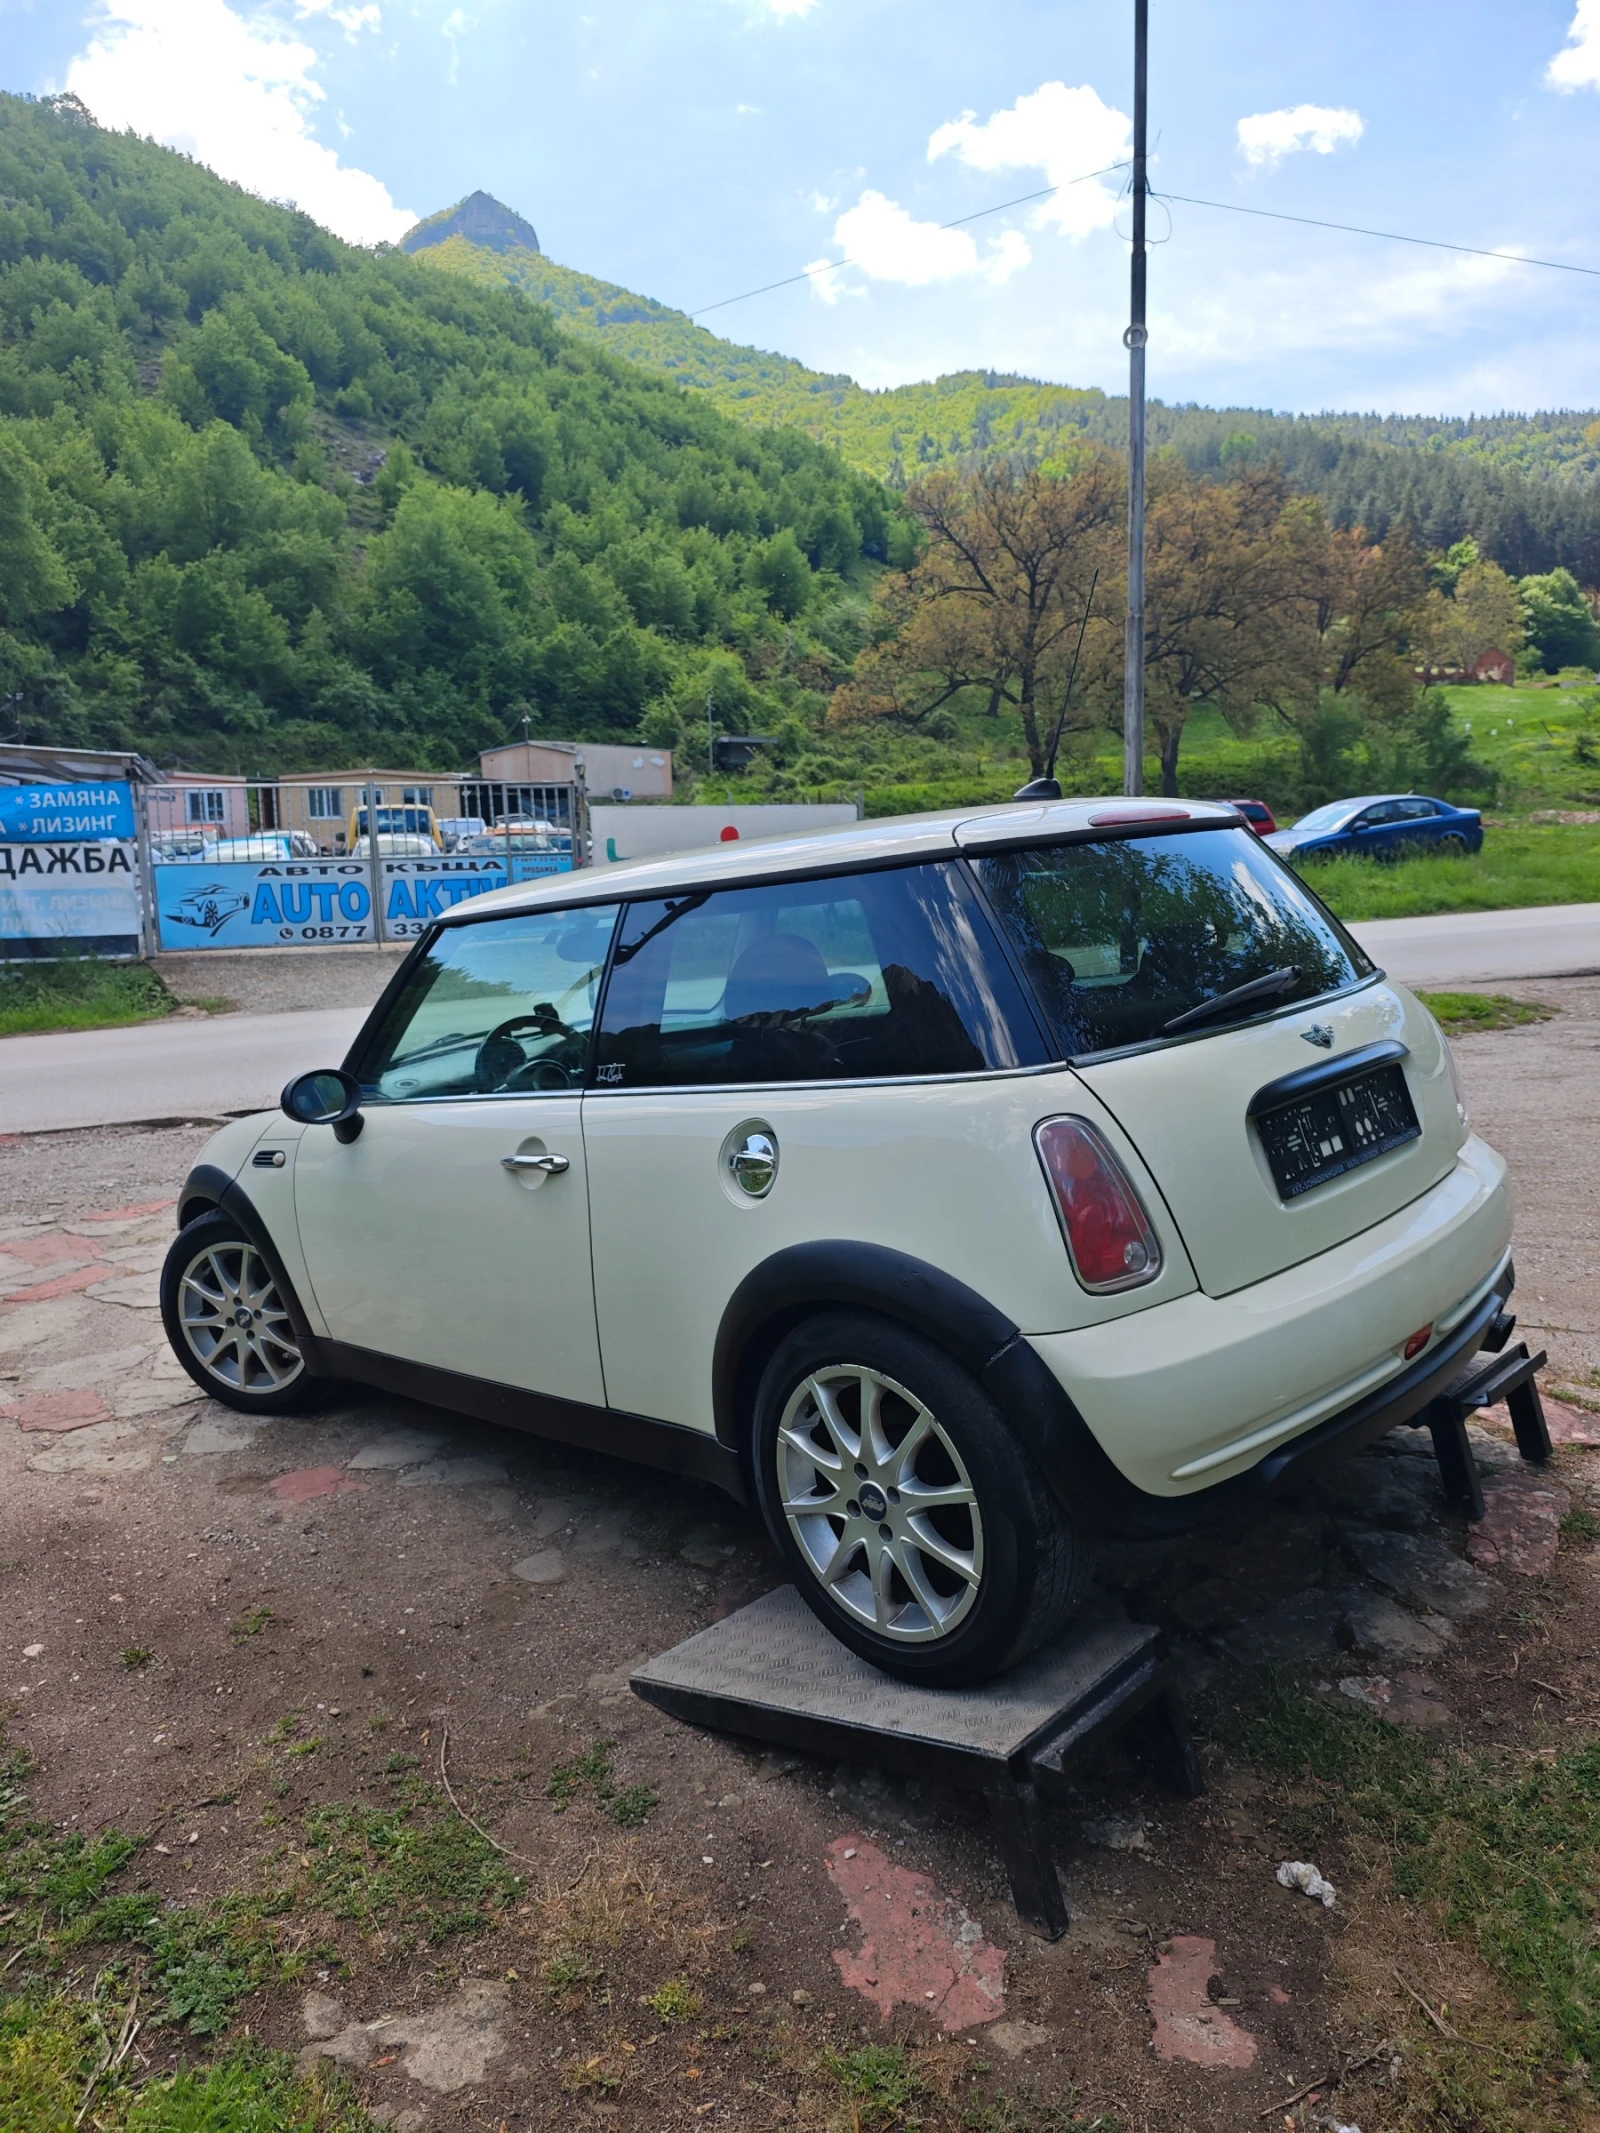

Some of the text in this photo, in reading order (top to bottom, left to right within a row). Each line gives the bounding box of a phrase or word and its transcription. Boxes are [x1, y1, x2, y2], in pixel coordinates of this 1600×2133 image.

[29, 789, 121, 809] ЗАМЯНА
[31, 814, 117, 834] ЛИЗИНГ
[0, 847, 131, 880] ДАЖБА
[257, 861, 503, 877] АВТО КЪЩА
[251, 881, 371, 924] AUTO
[301, 923, 424, 939] 0877 33
